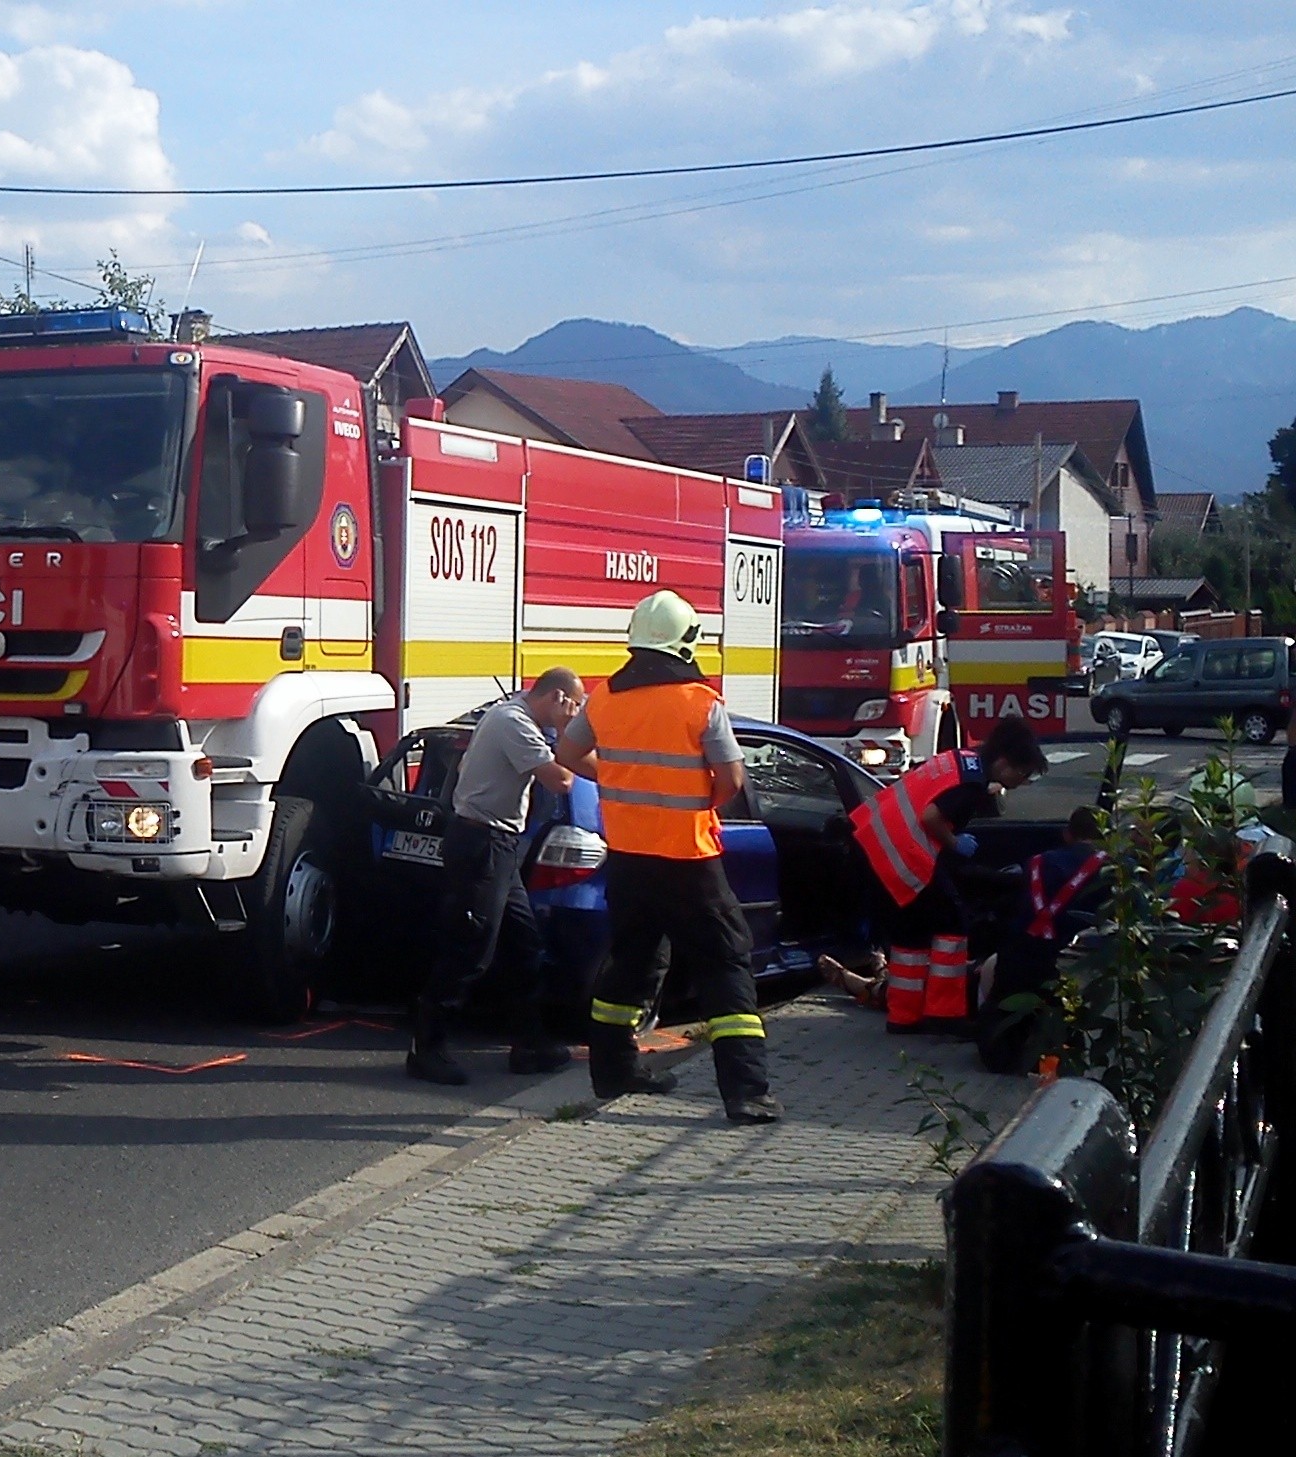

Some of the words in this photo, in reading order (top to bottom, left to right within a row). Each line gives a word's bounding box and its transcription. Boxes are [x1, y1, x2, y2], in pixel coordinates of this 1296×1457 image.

[333, 420, 361, 440] IVECO
[430, 515, 464, 581] SOS
[471, 523, 497, 583] 112
[605, 549, 658, 583] HASIČI
[751, 553, 773, 605] 150
[968, 693, 1064, 719] HASI
